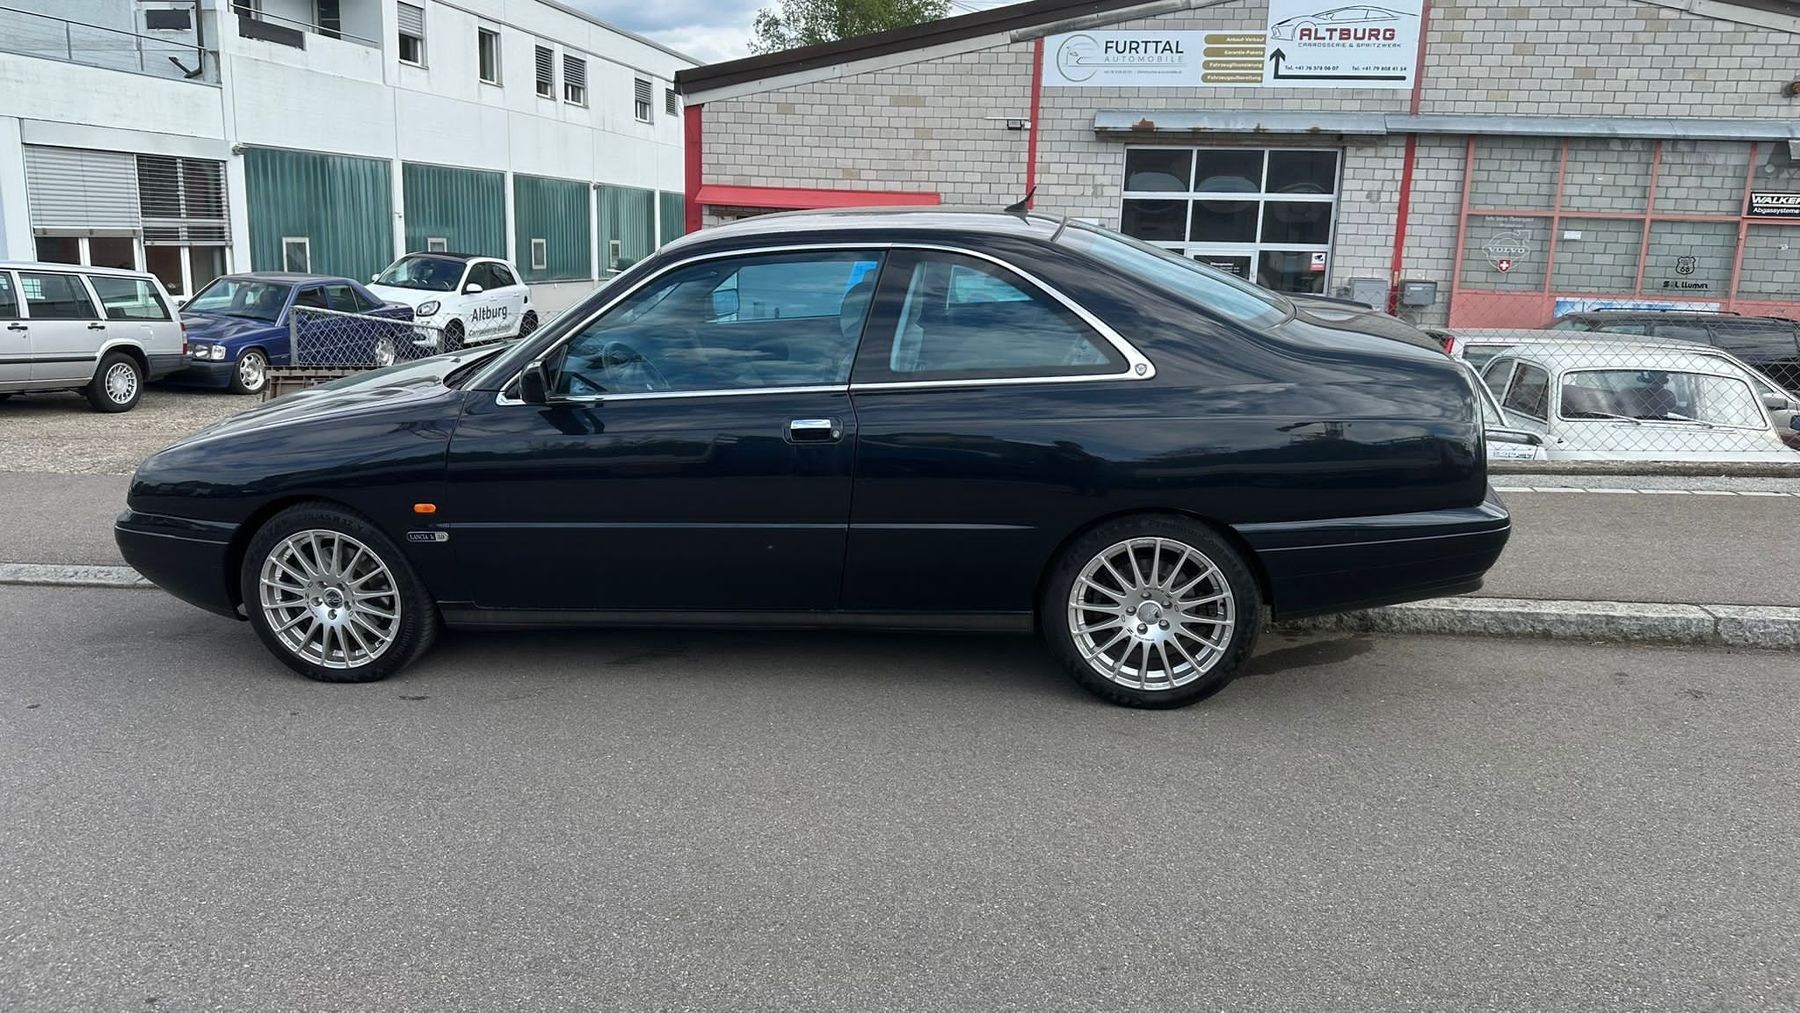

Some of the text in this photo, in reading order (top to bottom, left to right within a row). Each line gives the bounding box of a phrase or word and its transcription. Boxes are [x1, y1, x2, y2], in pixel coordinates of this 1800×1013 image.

[1299, 28, 1396, 41] ALTBURG
[1105, 40, 1184, 54] FURTTAL
[472, 306, 507, 322] Altburg
